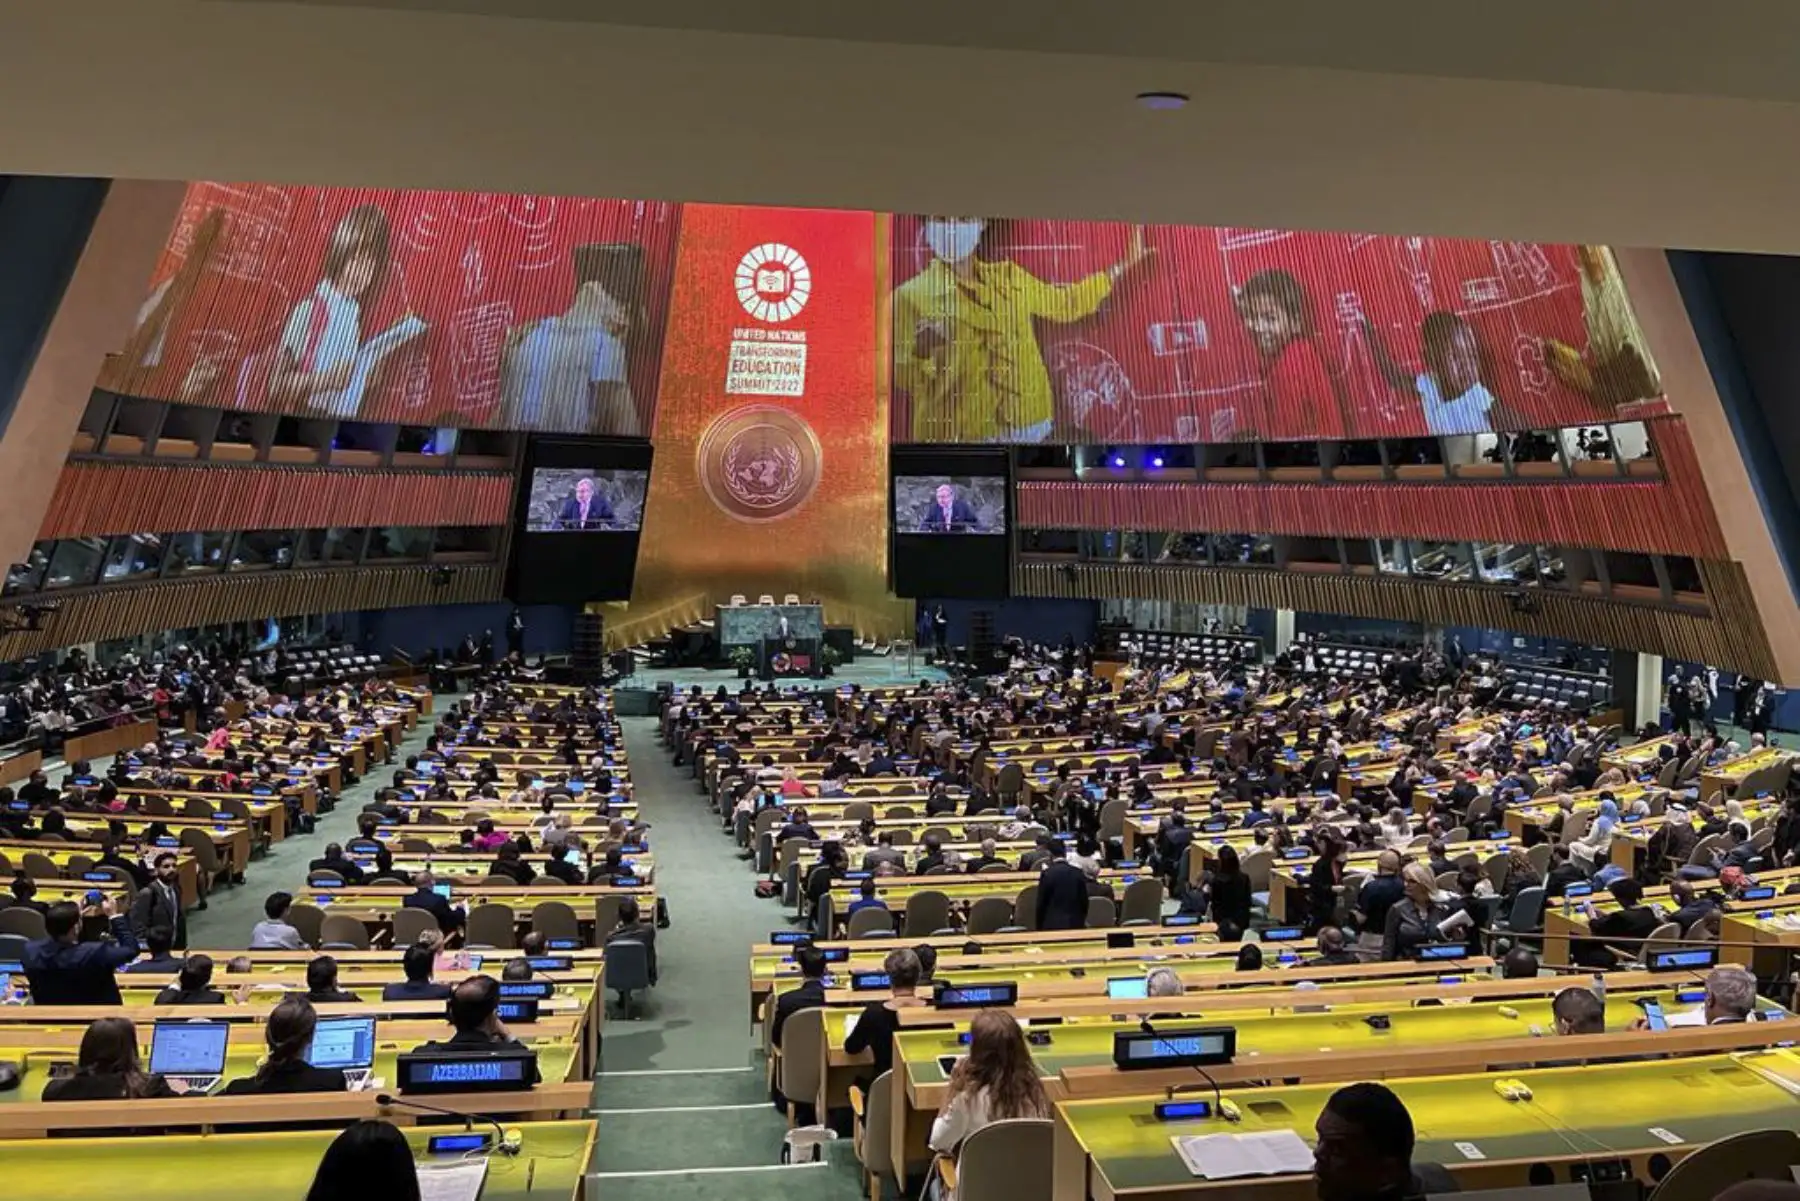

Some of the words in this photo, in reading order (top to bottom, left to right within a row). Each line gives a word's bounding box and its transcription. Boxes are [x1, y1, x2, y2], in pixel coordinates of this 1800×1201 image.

[733, 328, 766, 341] UNITED
[767, 329, 806, 342] NATIONS
[735, 345, 802, 359] TRANSFORMING
[732, 360, 801, 377] EDUCATION
[729, 377, 772, 390] SUMMIT
[431, 1063, 502, 1082] AZERBAIJAN
